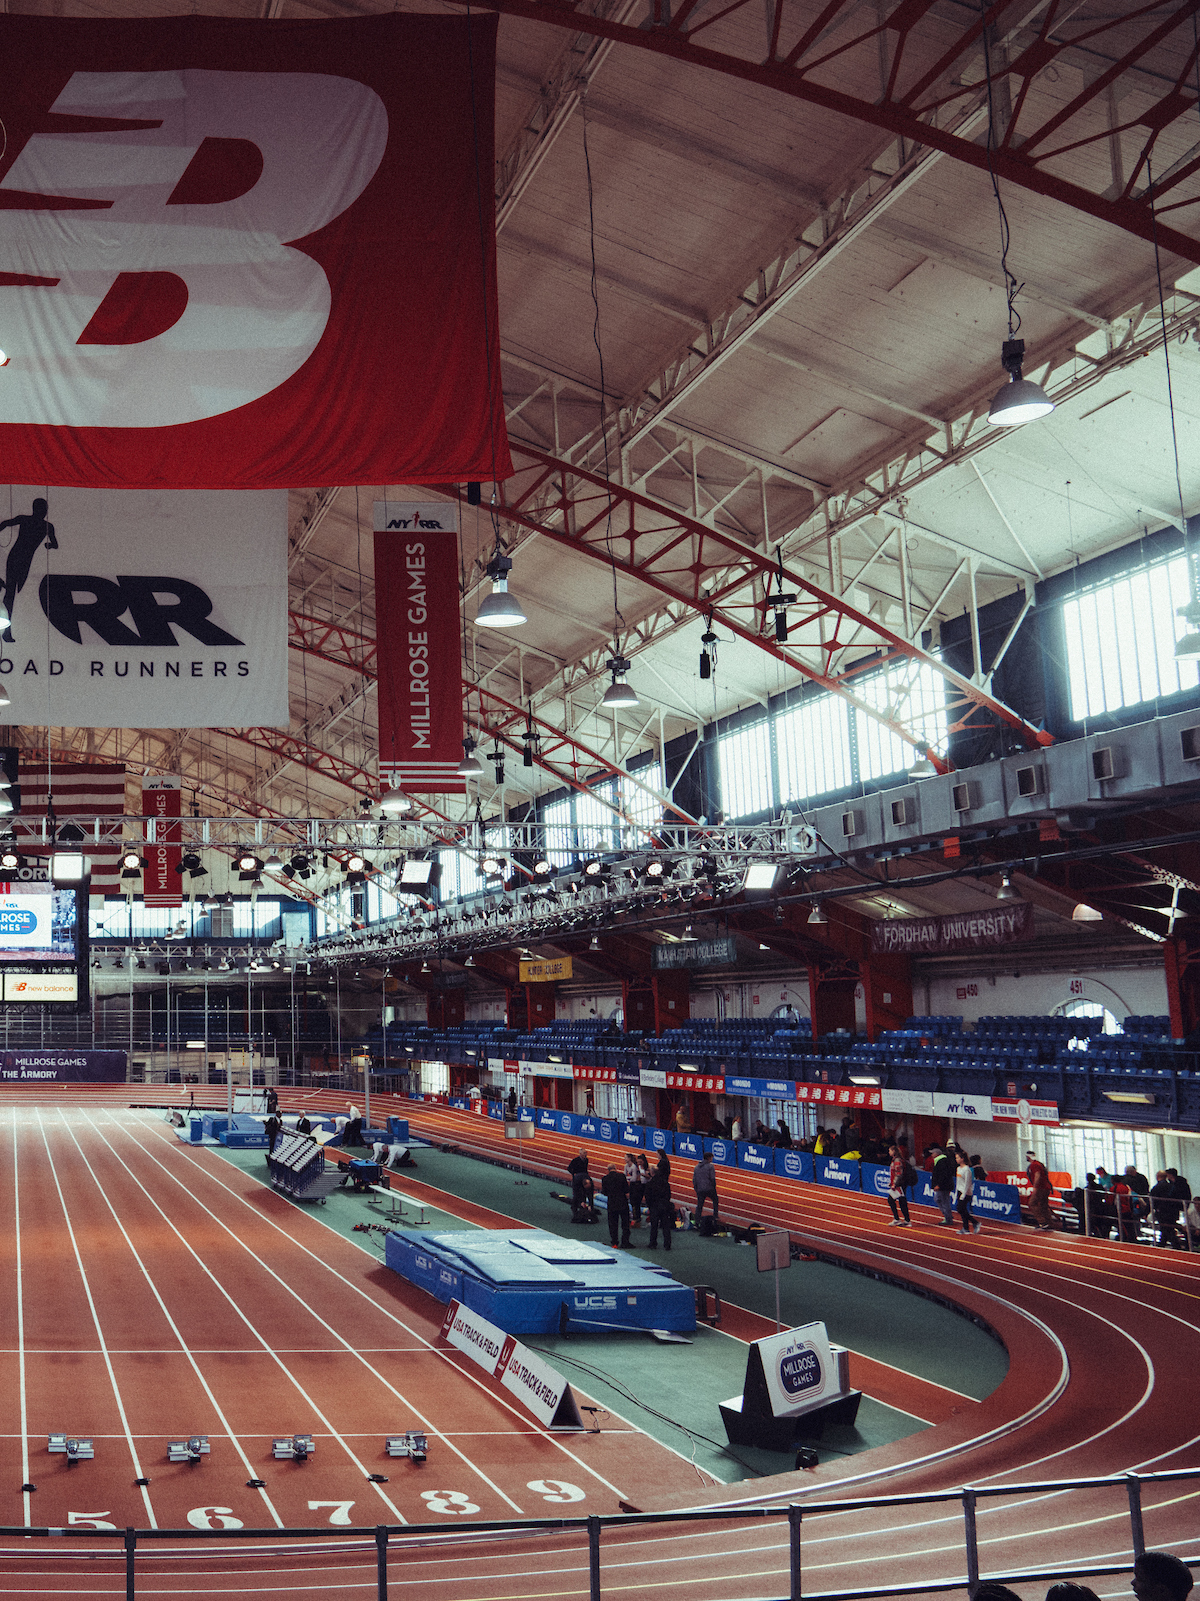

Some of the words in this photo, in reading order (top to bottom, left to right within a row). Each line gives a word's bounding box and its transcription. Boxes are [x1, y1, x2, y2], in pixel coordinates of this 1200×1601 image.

[405, 542, 428, 624] GAMES
[90, 660, 250, 678] RUNNERS
[408, 631, 431, 749] MILLROSE
[157, 836, 167, 889] MILLROE
[942, 914, 1016, 940] UNIVERSITY
[966, 984, 978, 997] 450
[1069, 980, 1083, 994] 451
[16, 1058, 56, 1066] MILLROSE
[58, 1058, 87, 1066] GAMES
[2, 1070, 18, 1078] THE
[20, 1070, 58, 1078] ARMORY
[1000, 1106, 1008, 1114] NEW
[1009, 1106, 1017, 1115] YORK
[1032, 1108, 1049, 1118] ATHLETIC
[624, 1132, 639, 1144] Armory
[748, 1146, 757, 1154] The
[744, 1153, 766, 1168] Armory
[829, 1160, 838, 1170] The
[824, 1167, 850, 1184] Armory
[1006, 1175, 1028, 1185] The
[980, 1186, 996, 1198] The
[971, 1196, 1012, 1214] Armory
[415, 1255, 427, 1267] UCS
[574, 1296, 617, 1307] UCS
[453, 1317, 464, 1334] USA
[462, 1324, 482, 1345] TRACK
[482, 1338, 500, 1358] FIELD
[782, 1355, 816, 1376] MILLROSE
[508, 1357, 522, 1376] USA
[518, 1366, 538, 1392] TRACK
[538, 1385, 558, 1409] FIELD
[792, 1372, 814, 1387] GAMES
[526, 1479, 586, 1503] 9
[420, 1489, 482, 1515] 8
[67, 1510, 117, 1529] 5
[186, 1505, 245, 1529] 6
[307, 1500, 356, 1525] 7
